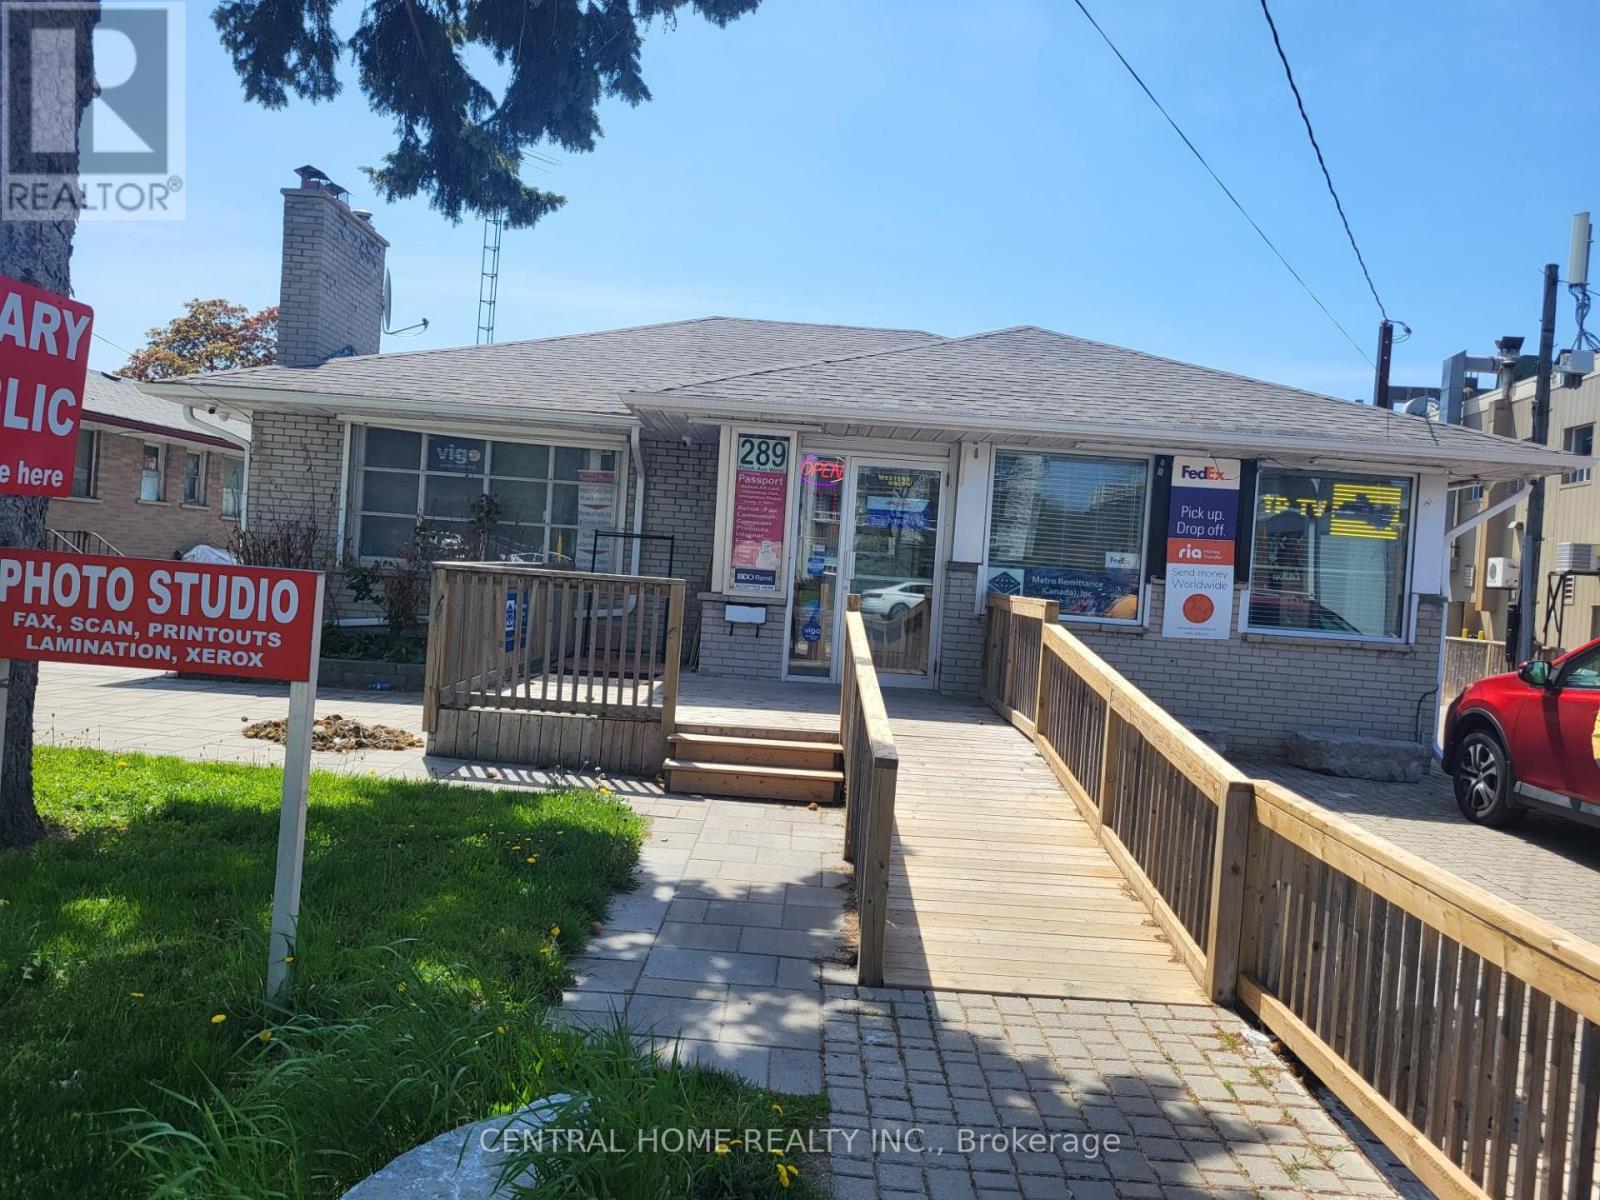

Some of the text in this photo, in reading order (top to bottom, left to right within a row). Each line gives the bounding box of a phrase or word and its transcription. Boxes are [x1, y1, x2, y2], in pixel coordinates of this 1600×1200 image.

[0, 377, 76, 437] LIC
[437, 444, 480, 464] vigo
[740, 438, 786, 467] 289
[17, 460, 64, 487] here
[800, 461, 845, 479] OPEN
[1181, 465, 1224, 481] FedEx
[738, 473, 784, 486] Passport
[1181, 505, 1225, 523] Pick up.
[1176, 521, 1226, 538] Drop off.
[1178, 544, 1202, 559] ria
[737, 573, 773, 582] BDO Remit
[1032, 576, 1104, 588] Metro Remittance
[1172, 567, 1228, 581] Send money
[0, 558, 299, 624] PHOTO STUDIO
[1172, 580, 1228, 591] Worldwide
[13, 612, 282, 648] FAX, SCAN, PRINTOUTS
[803, 627, 821, 636] vigo
[26, 634, 264, 668] LAMINATION, XEROX
